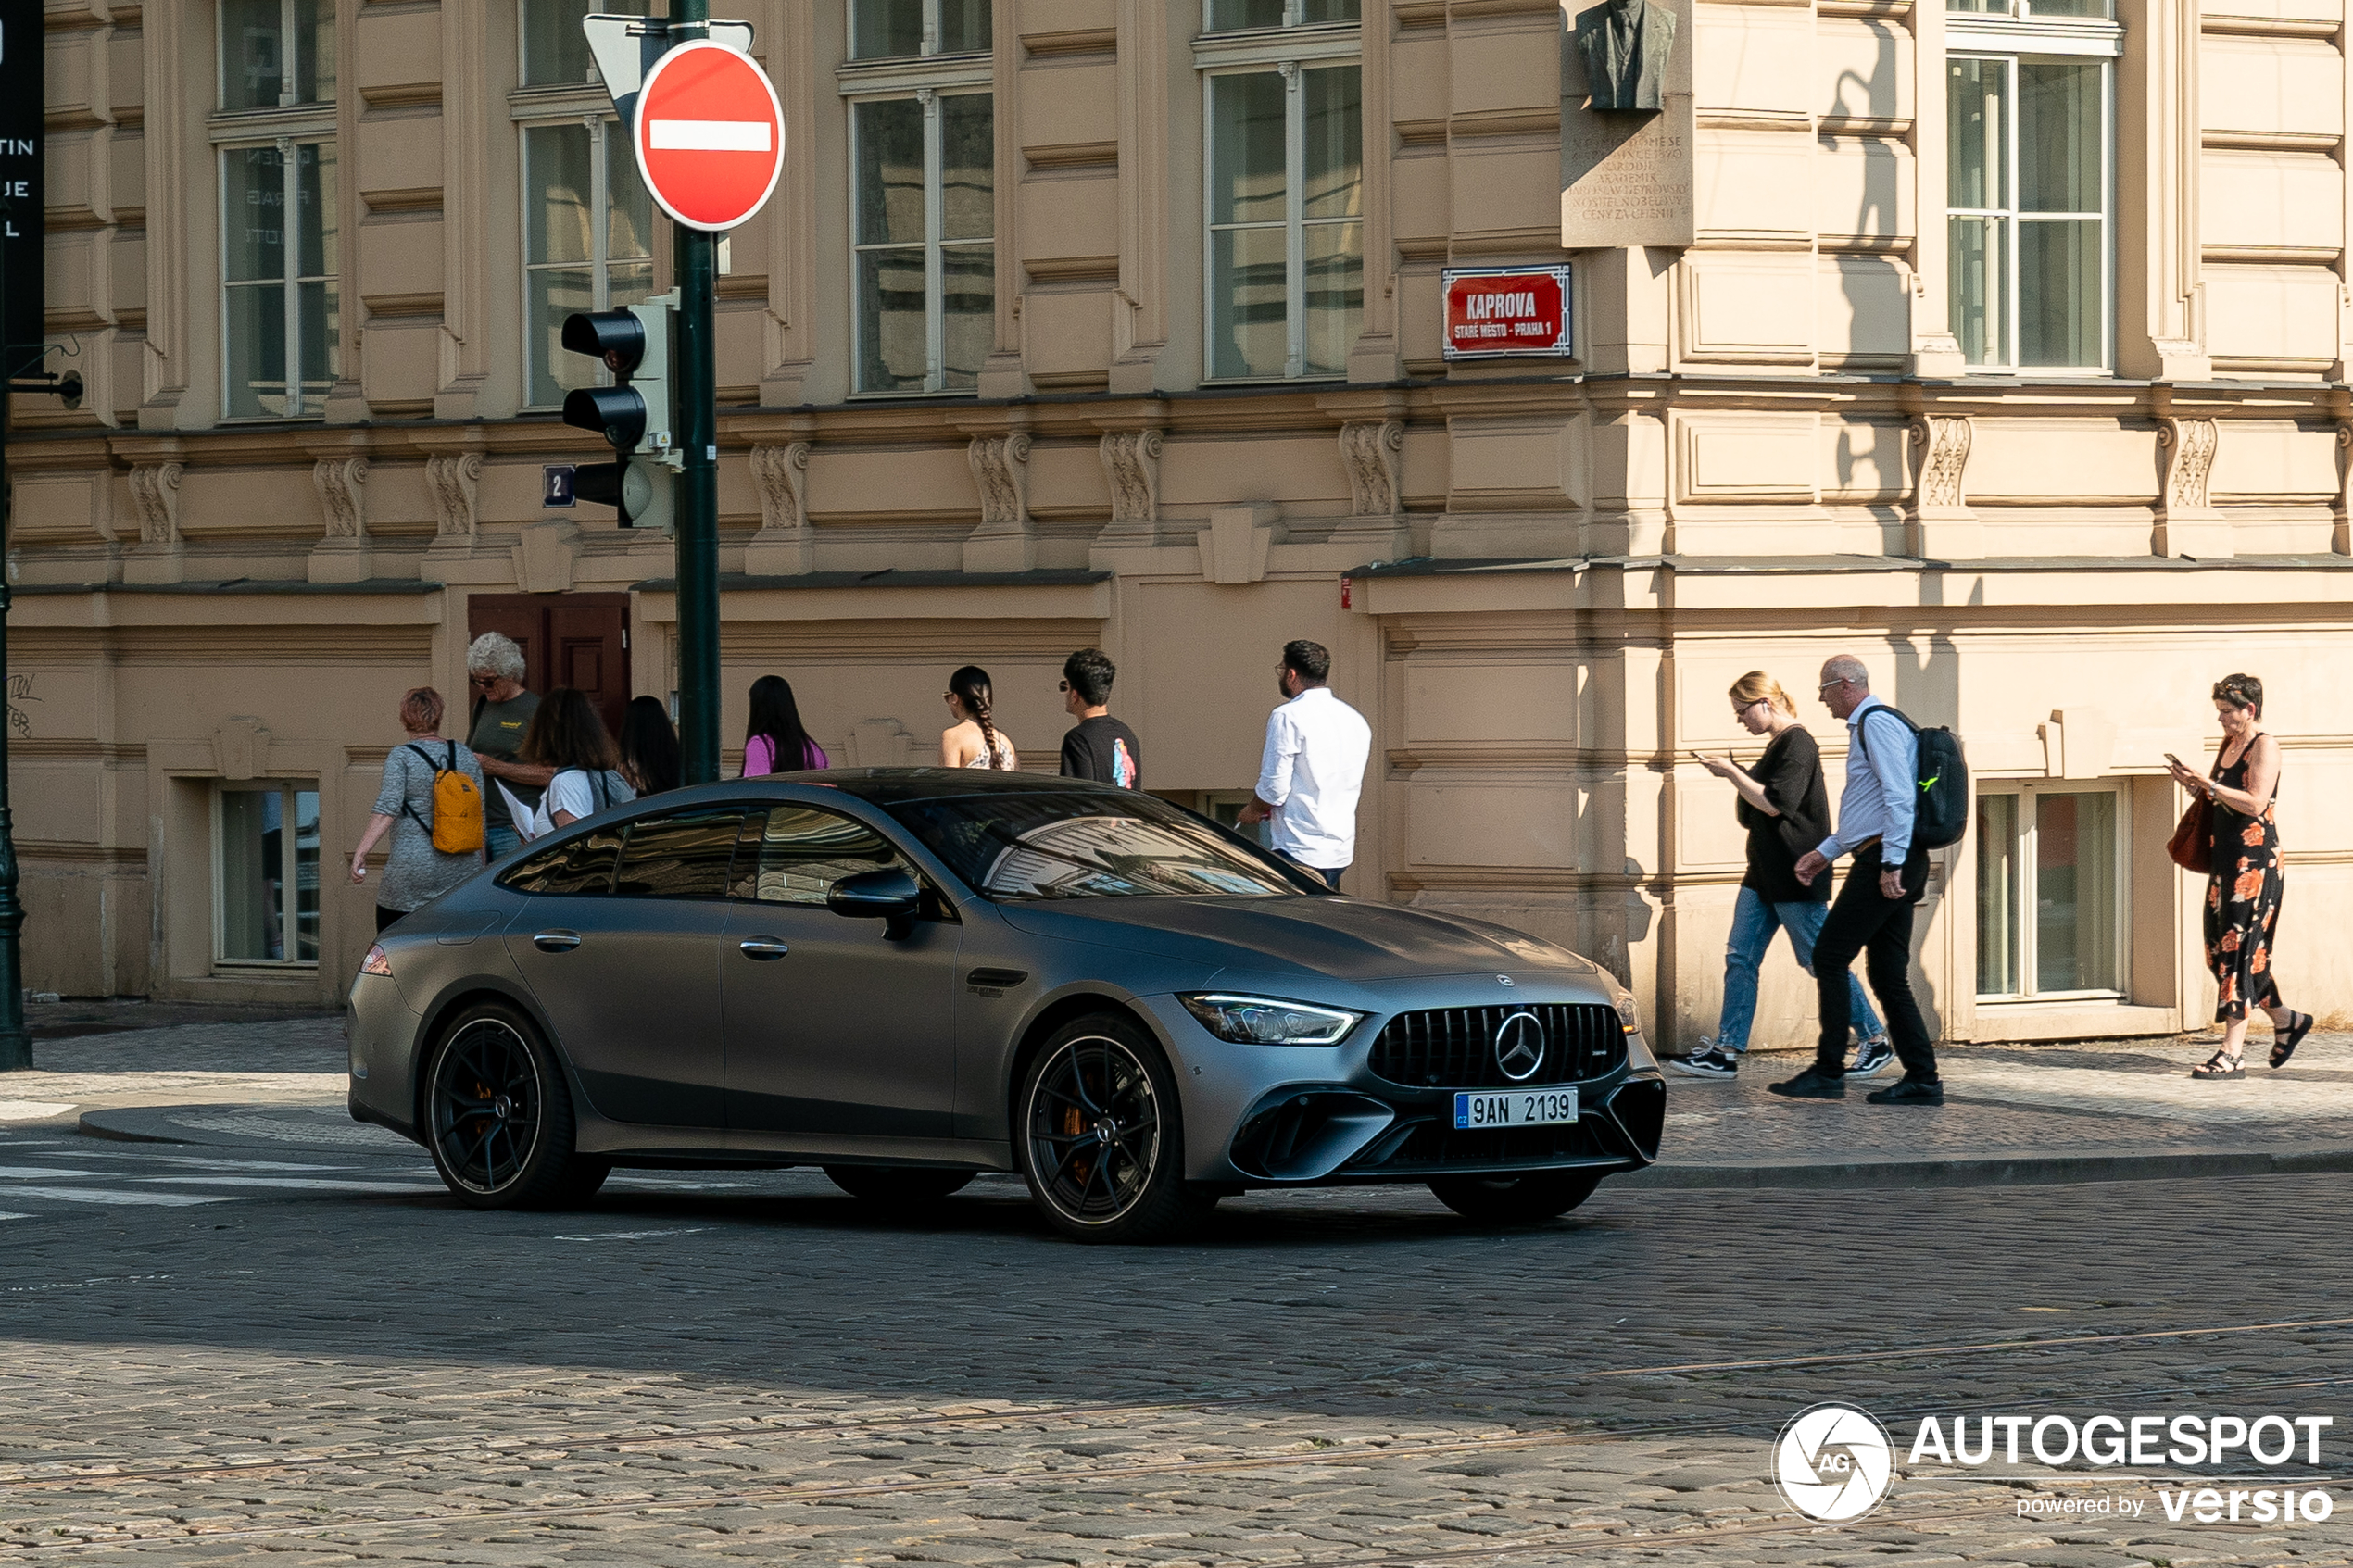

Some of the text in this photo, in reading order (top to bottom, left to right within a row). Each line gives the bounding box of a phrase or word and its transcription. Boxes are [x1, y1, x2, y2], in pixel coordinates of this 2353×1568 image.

[1466, 292, 1536, 320] KAPROVA
[1454, 321, 1479, 339] STARÉ
[1480, 321, 1507, 337] MĚSTO
[1515, 322, 1544, 337] PRAHA
[1546, 322, 1552, 335] 1
[553, 475, 561, 497] 2
[1457, 1115, 1467, 1124] CZ
[1473, 1094, 1569, 1123] 9AN 2139
